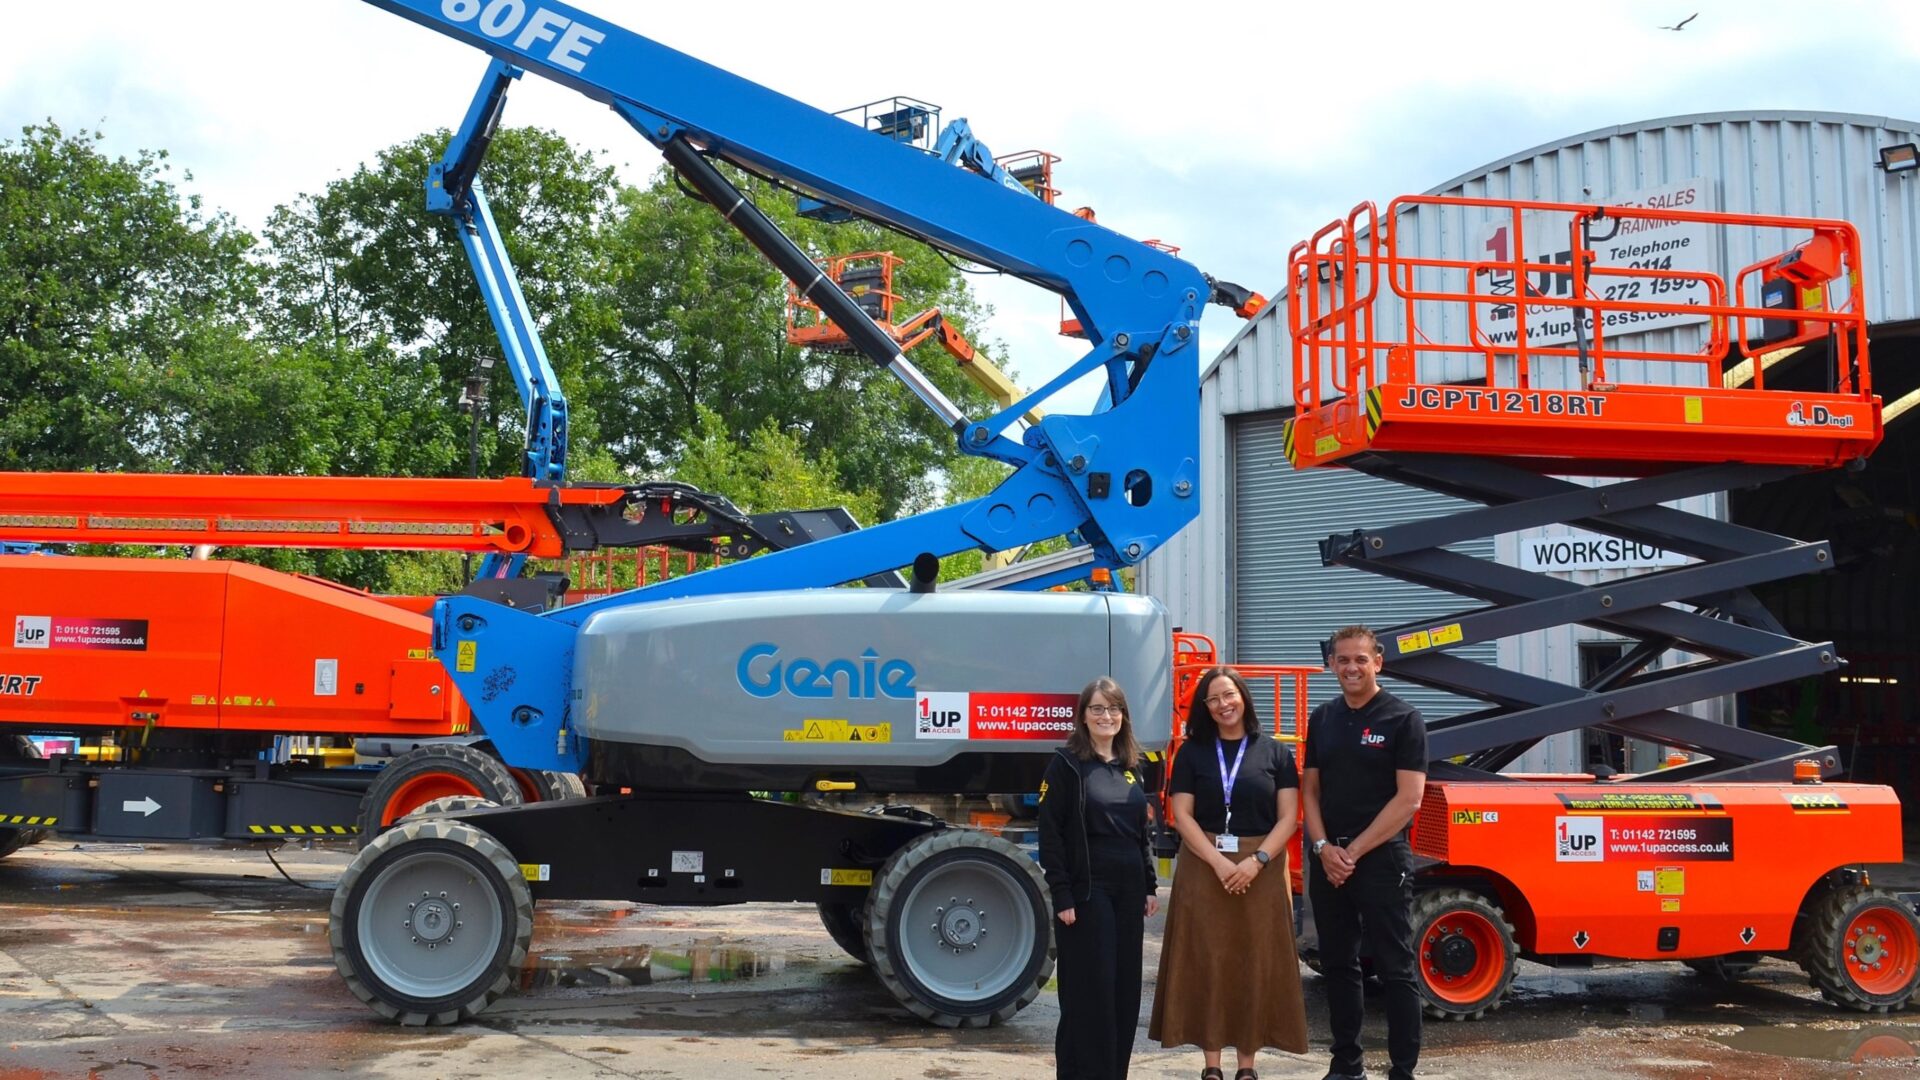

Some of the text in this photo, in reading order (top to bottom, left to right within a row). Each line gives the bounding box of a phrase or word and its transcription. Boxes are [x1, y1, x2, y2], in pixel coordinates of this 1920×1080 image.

[1648, 188, 1696, 209] SALES
[1609, 237, 1690, 260] Telephone
[1605, 278, 1699, 301] 272 1595
[1400, 387, 1606, 416] JCPT1218RT
[1812, 405, 1853, 427] Dingli
[55, 625, 120, 635] T: 01142 721595
[54, 635, 145, 646] www.1upaccess.co.uk
[736, 642, 917, 700] Genie
[0, 675, 41, 695] RT
[976, 705, 1073, 718] T: 01142 721595
[1600, 800, 1636, 808] TERRAIN
[1670, 800, 1695, 808] LIFTS
[1453, 808, 1481, 823] IPAF
[1610, 829, 1696, 840] T: 01142 721595
[1610, 841, 1729, 855] www.1upaccess.co.uk
